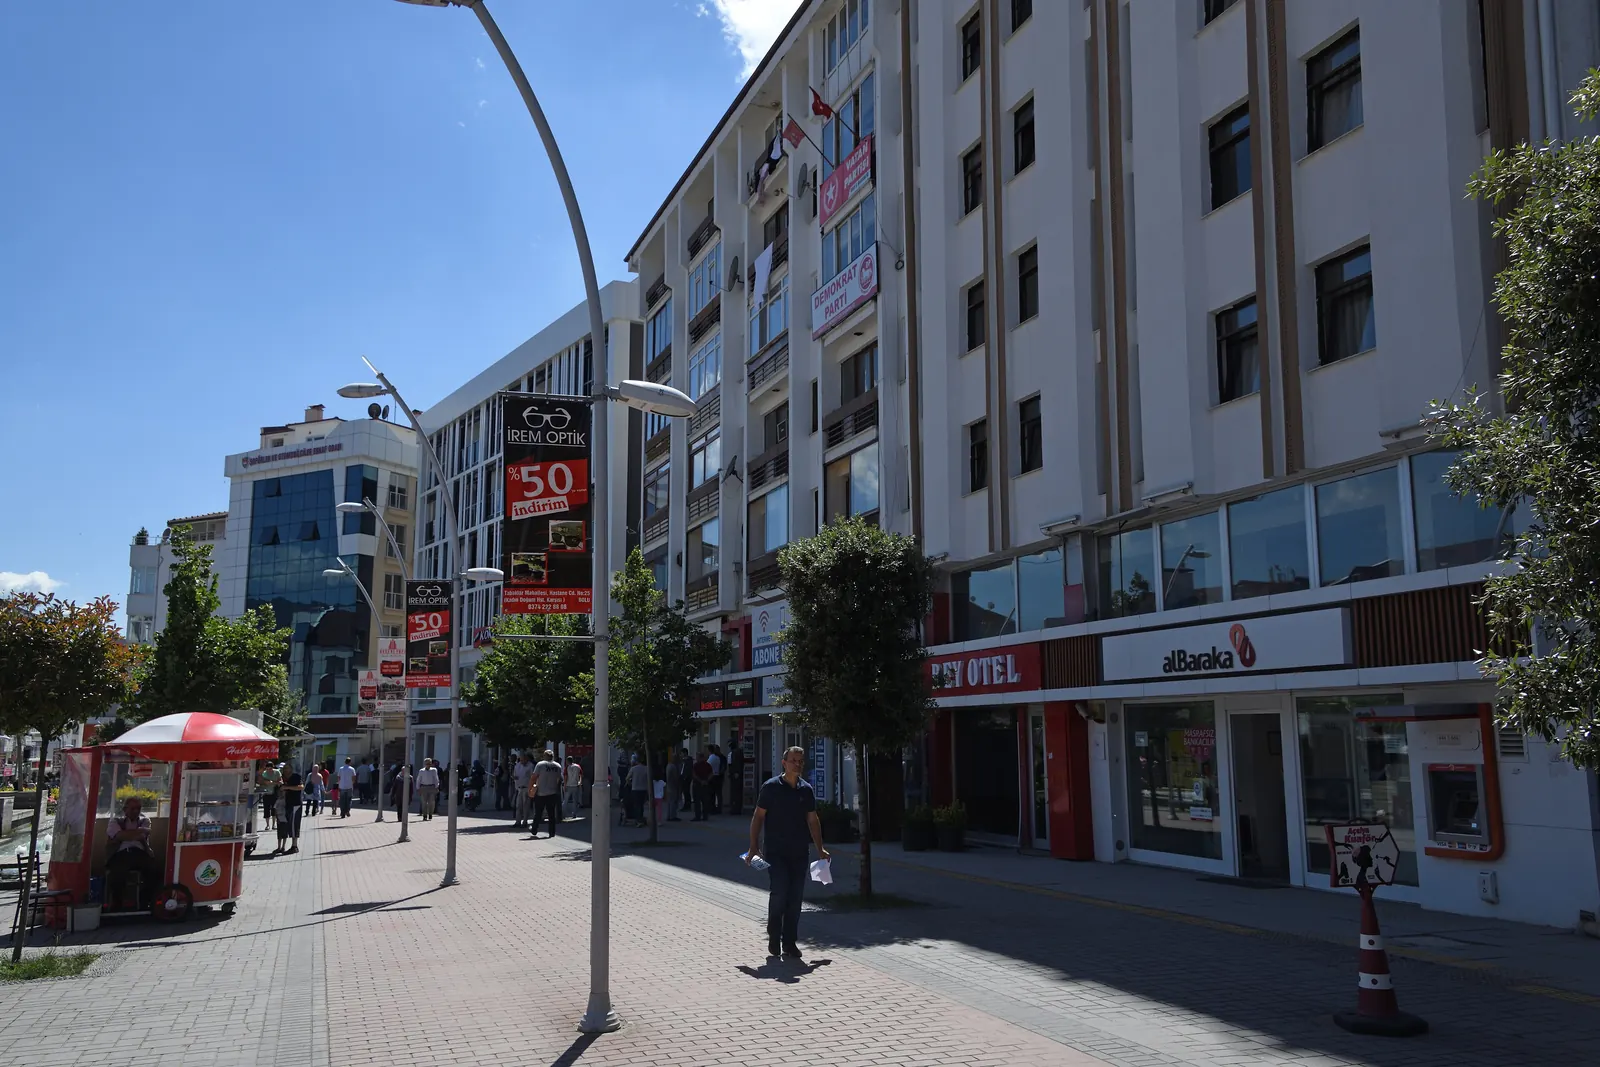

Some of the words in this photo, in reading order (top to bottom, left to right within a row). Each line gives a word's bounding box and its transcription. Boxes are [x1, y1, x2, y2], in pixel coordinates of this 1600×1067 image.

[845, 141, 869, 171] VATAN
[814, 263, 858, 310] DEMOKRAT
[824, 288, 848, 320] PARTİ
[507, 426, 541, 443] İREM
[546, 430, 586, 445] OPTİK
[513, 499, 568, 516] indirim
[408, 595, 427, 604] İREM
[428, 596, 449, 604] OPTİK
[411, 631, 439, 640] indirim
[754, 645, 780, 666] ABONE
[1162, 645, 1234, 673] alBaraka
[967, 654, 1022, 686] OTEL
[1183, 737, 1216, 747] BANKACILIK
